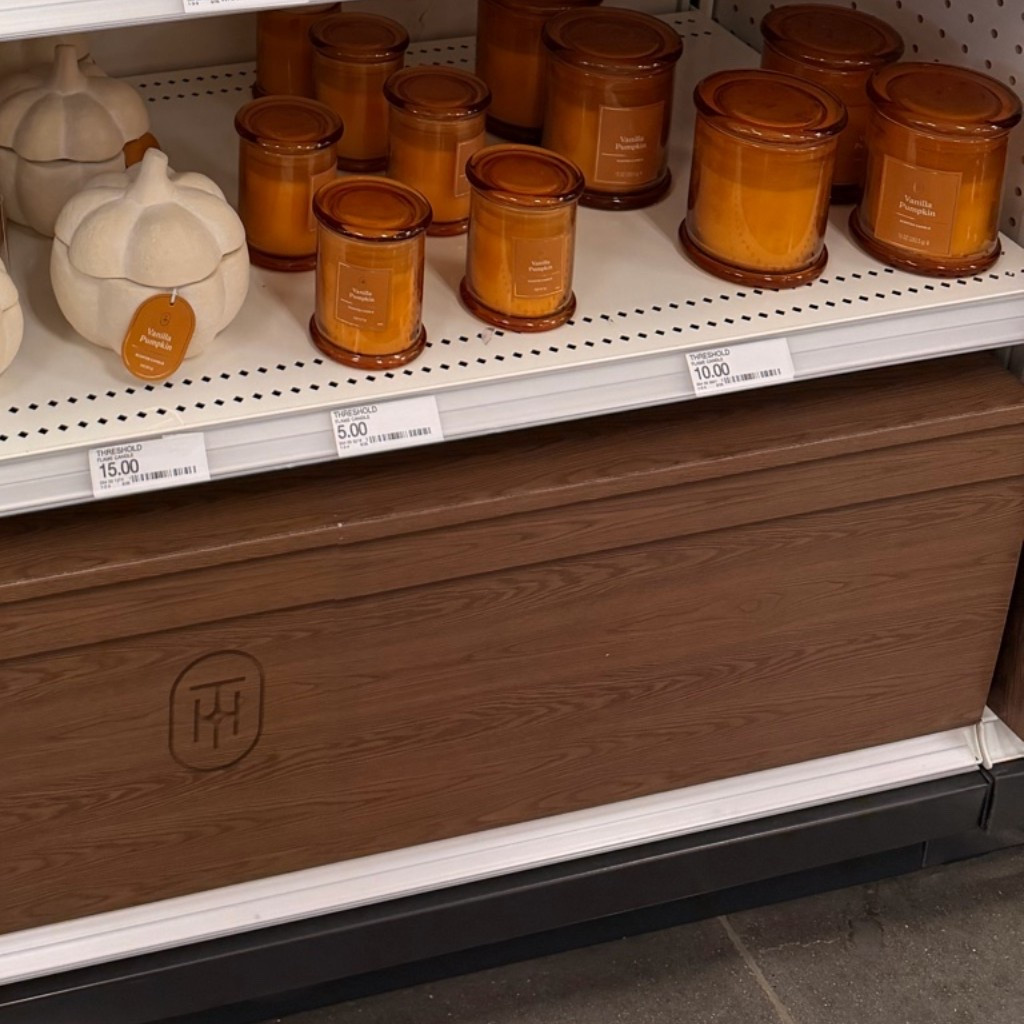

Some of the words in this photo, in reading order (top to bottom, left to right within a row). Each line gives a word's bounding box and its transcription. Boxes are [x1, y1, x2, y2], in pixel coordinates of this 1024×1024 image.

[904, 194, 932, 208] Vanilla
[899, 201, 936, 216] Pumpkin
[148, 328, 172, 342] Vanilla
[140, 334, 172, 351] Pumpkin
[690, 349, 730, 361] THRESHOLD
[695, 362, 730, 380] 10.00
[334, 406, 378, 418] THRESHOLD
[337, 421, 368, 439] 5.00
[96, 444, 142, 456] THRESHOLD
[100, 459, 139, 478] 15.00
